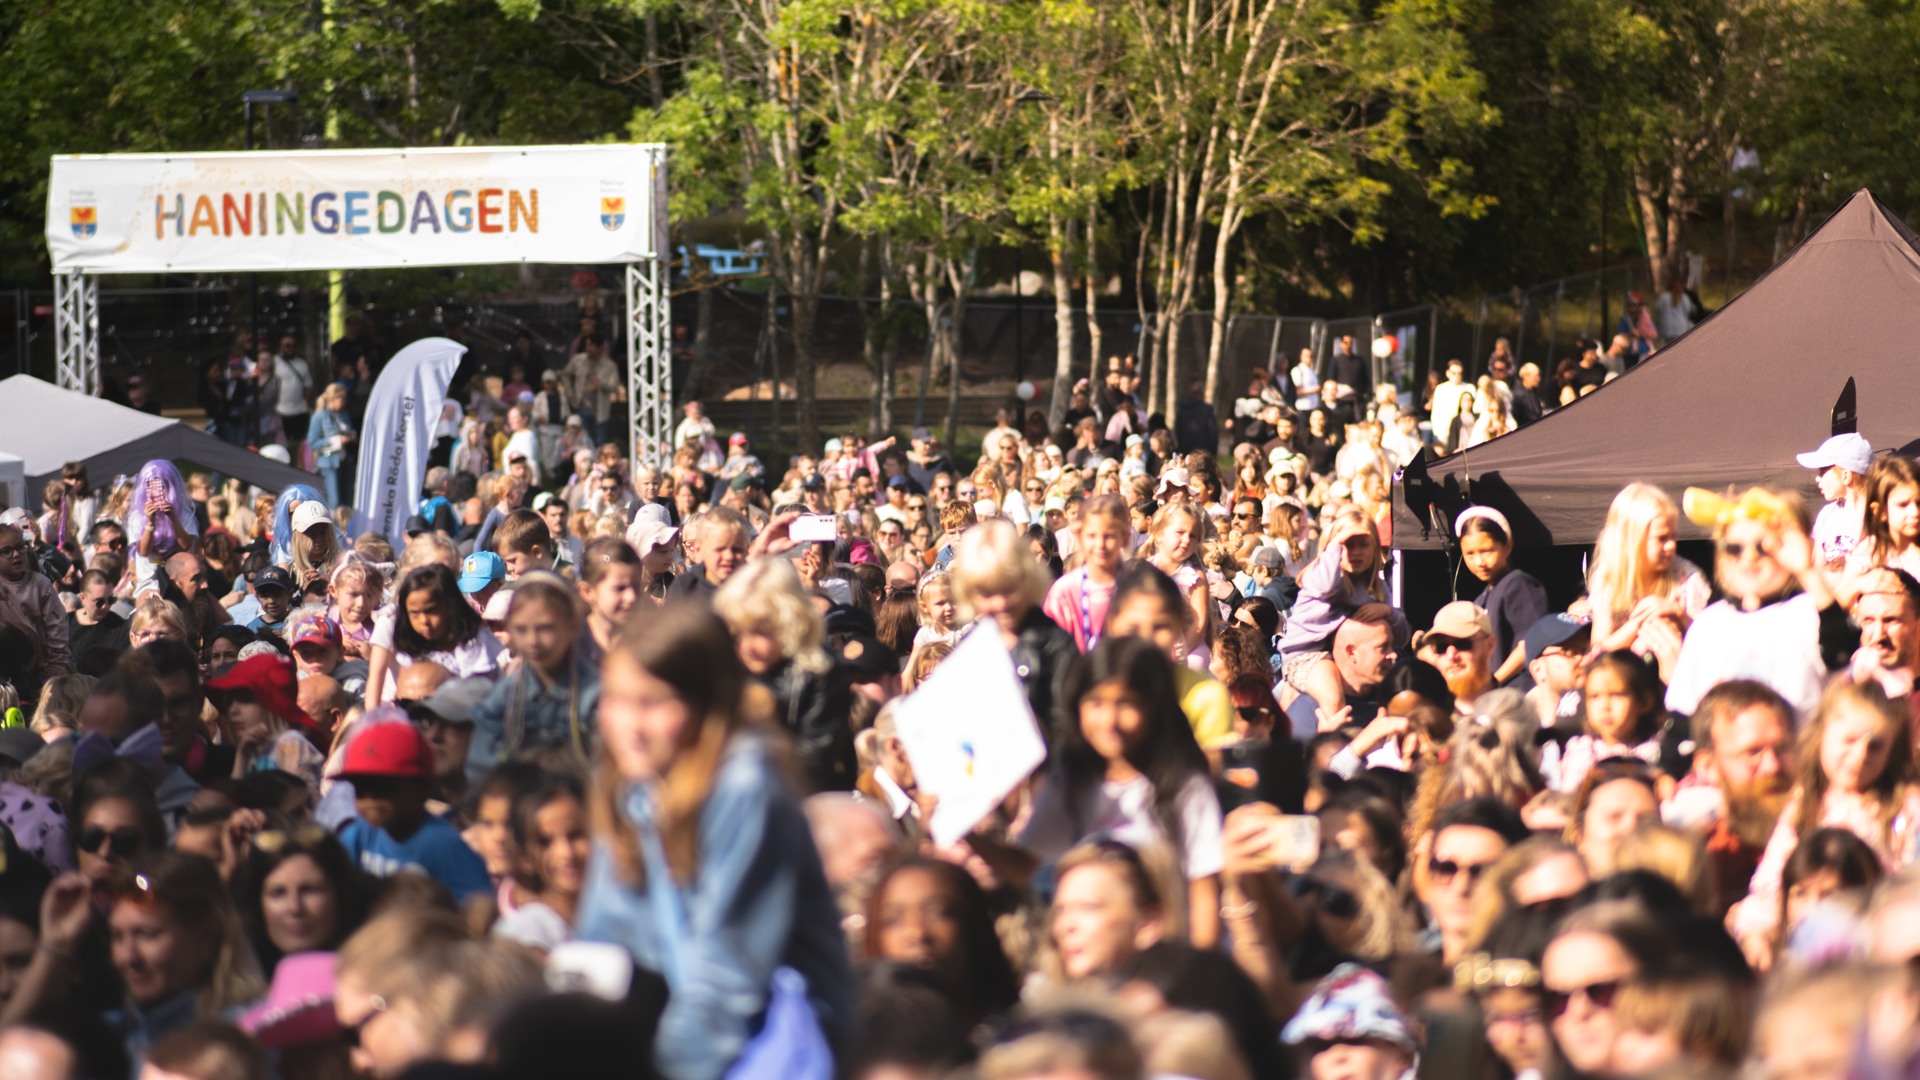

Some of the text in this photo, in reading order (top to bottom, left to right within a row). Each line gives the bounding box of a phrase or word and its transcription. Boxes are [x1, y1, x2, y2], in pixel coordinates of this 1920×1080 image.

[155, 188, 540, 240] HANINGEDAGEN
[382, 396, 415, 538] enska Röda Korset
